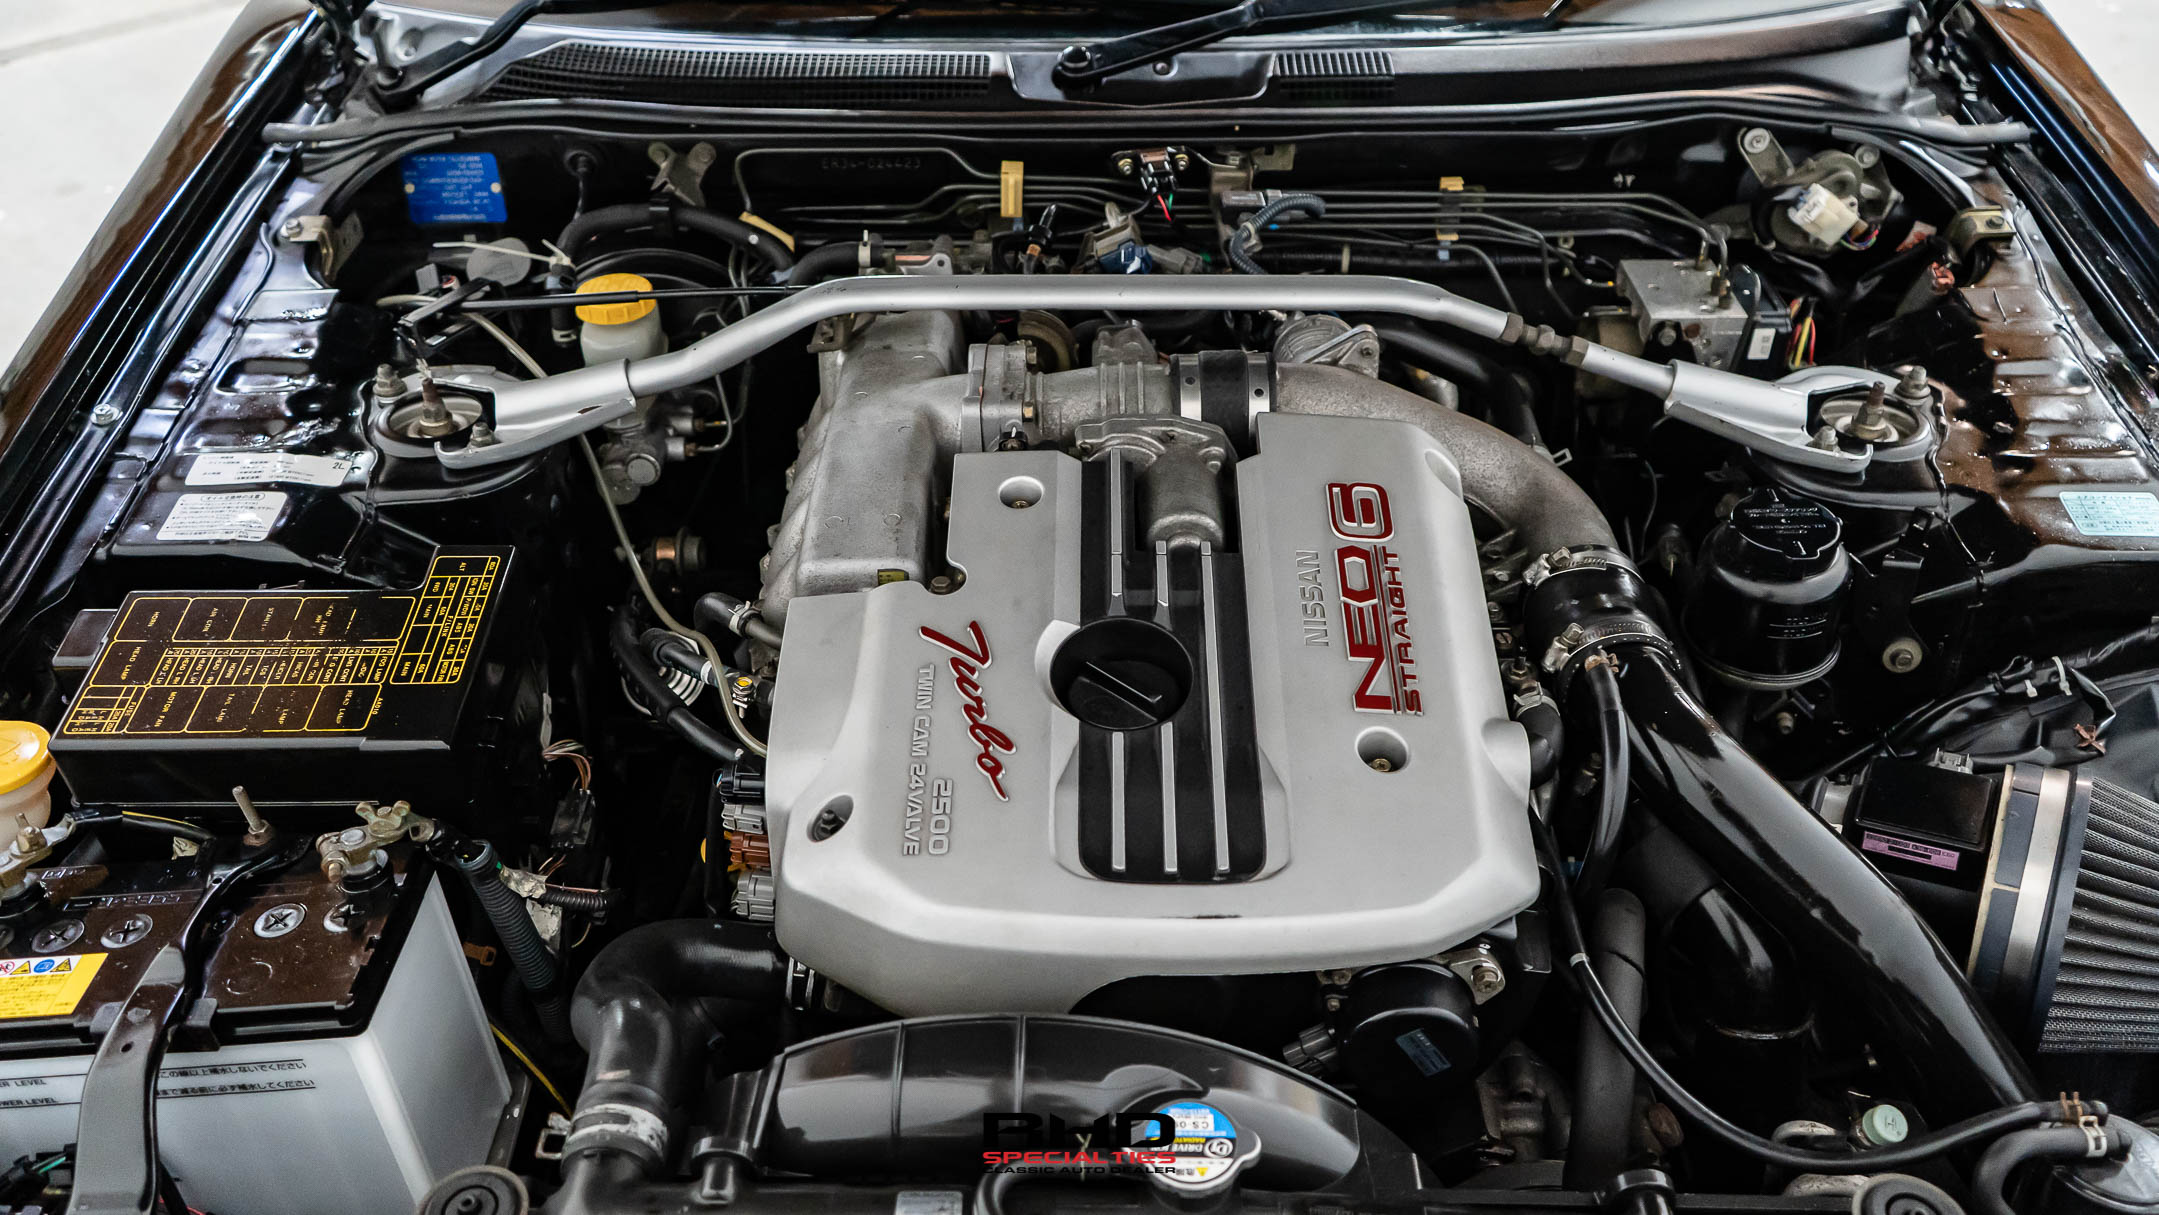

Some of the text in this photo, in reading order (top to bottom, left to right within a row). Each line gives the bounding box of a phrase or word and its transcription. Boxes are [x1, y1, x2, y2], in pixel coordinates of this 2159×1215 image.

[332, 461, 345, 470] 2L
[468, 587, 475, 595] SW
[1296, 550, 1329, 647] NISSAN
[147, 612, 160, 626] HORN
[210, 608, 218, 617] AIR
[442, 615, 453, 636] F/LINK
[454, 622, 462, 632] ABS
[1382, 545, 1425, 716] STRAIGHT
[446, 644, 455, 654] ABS
[121, 647, 141, 680] HEAD LAMP
[162, 658, 173, 671] HEAD
[179, 658, 189, 670] HEAD
[195, 658, 206, 670] HEAD
[212, 658, 222, 670] HEAD
[225, 663, 237, 678] HORN
[242, 665, 253, 675] TAIL
[374, 656, 387, 681] FOG LAMP
[401, 661, 411, 676] MAIN
[323, 668, 333, 682] CONT
[339, 668, 350, 682] CONT
[916, 664, 935, 709] TWIN
[343, 690, 353, 705] HEAD
[125, 702, 136, 716] FUSE
[154, 692, 177, 727] MOTOR FAN
[919, 620, 1017, 801] Turbo
[278, 709, 288, 724] LAMP
[912, 715, 930, 757] CAM
[928, 779, 953, 855] 2500
[14, 1079, 47, 1087] LEVEL
[1172, 1142, 1203, 1152] DRIVE
